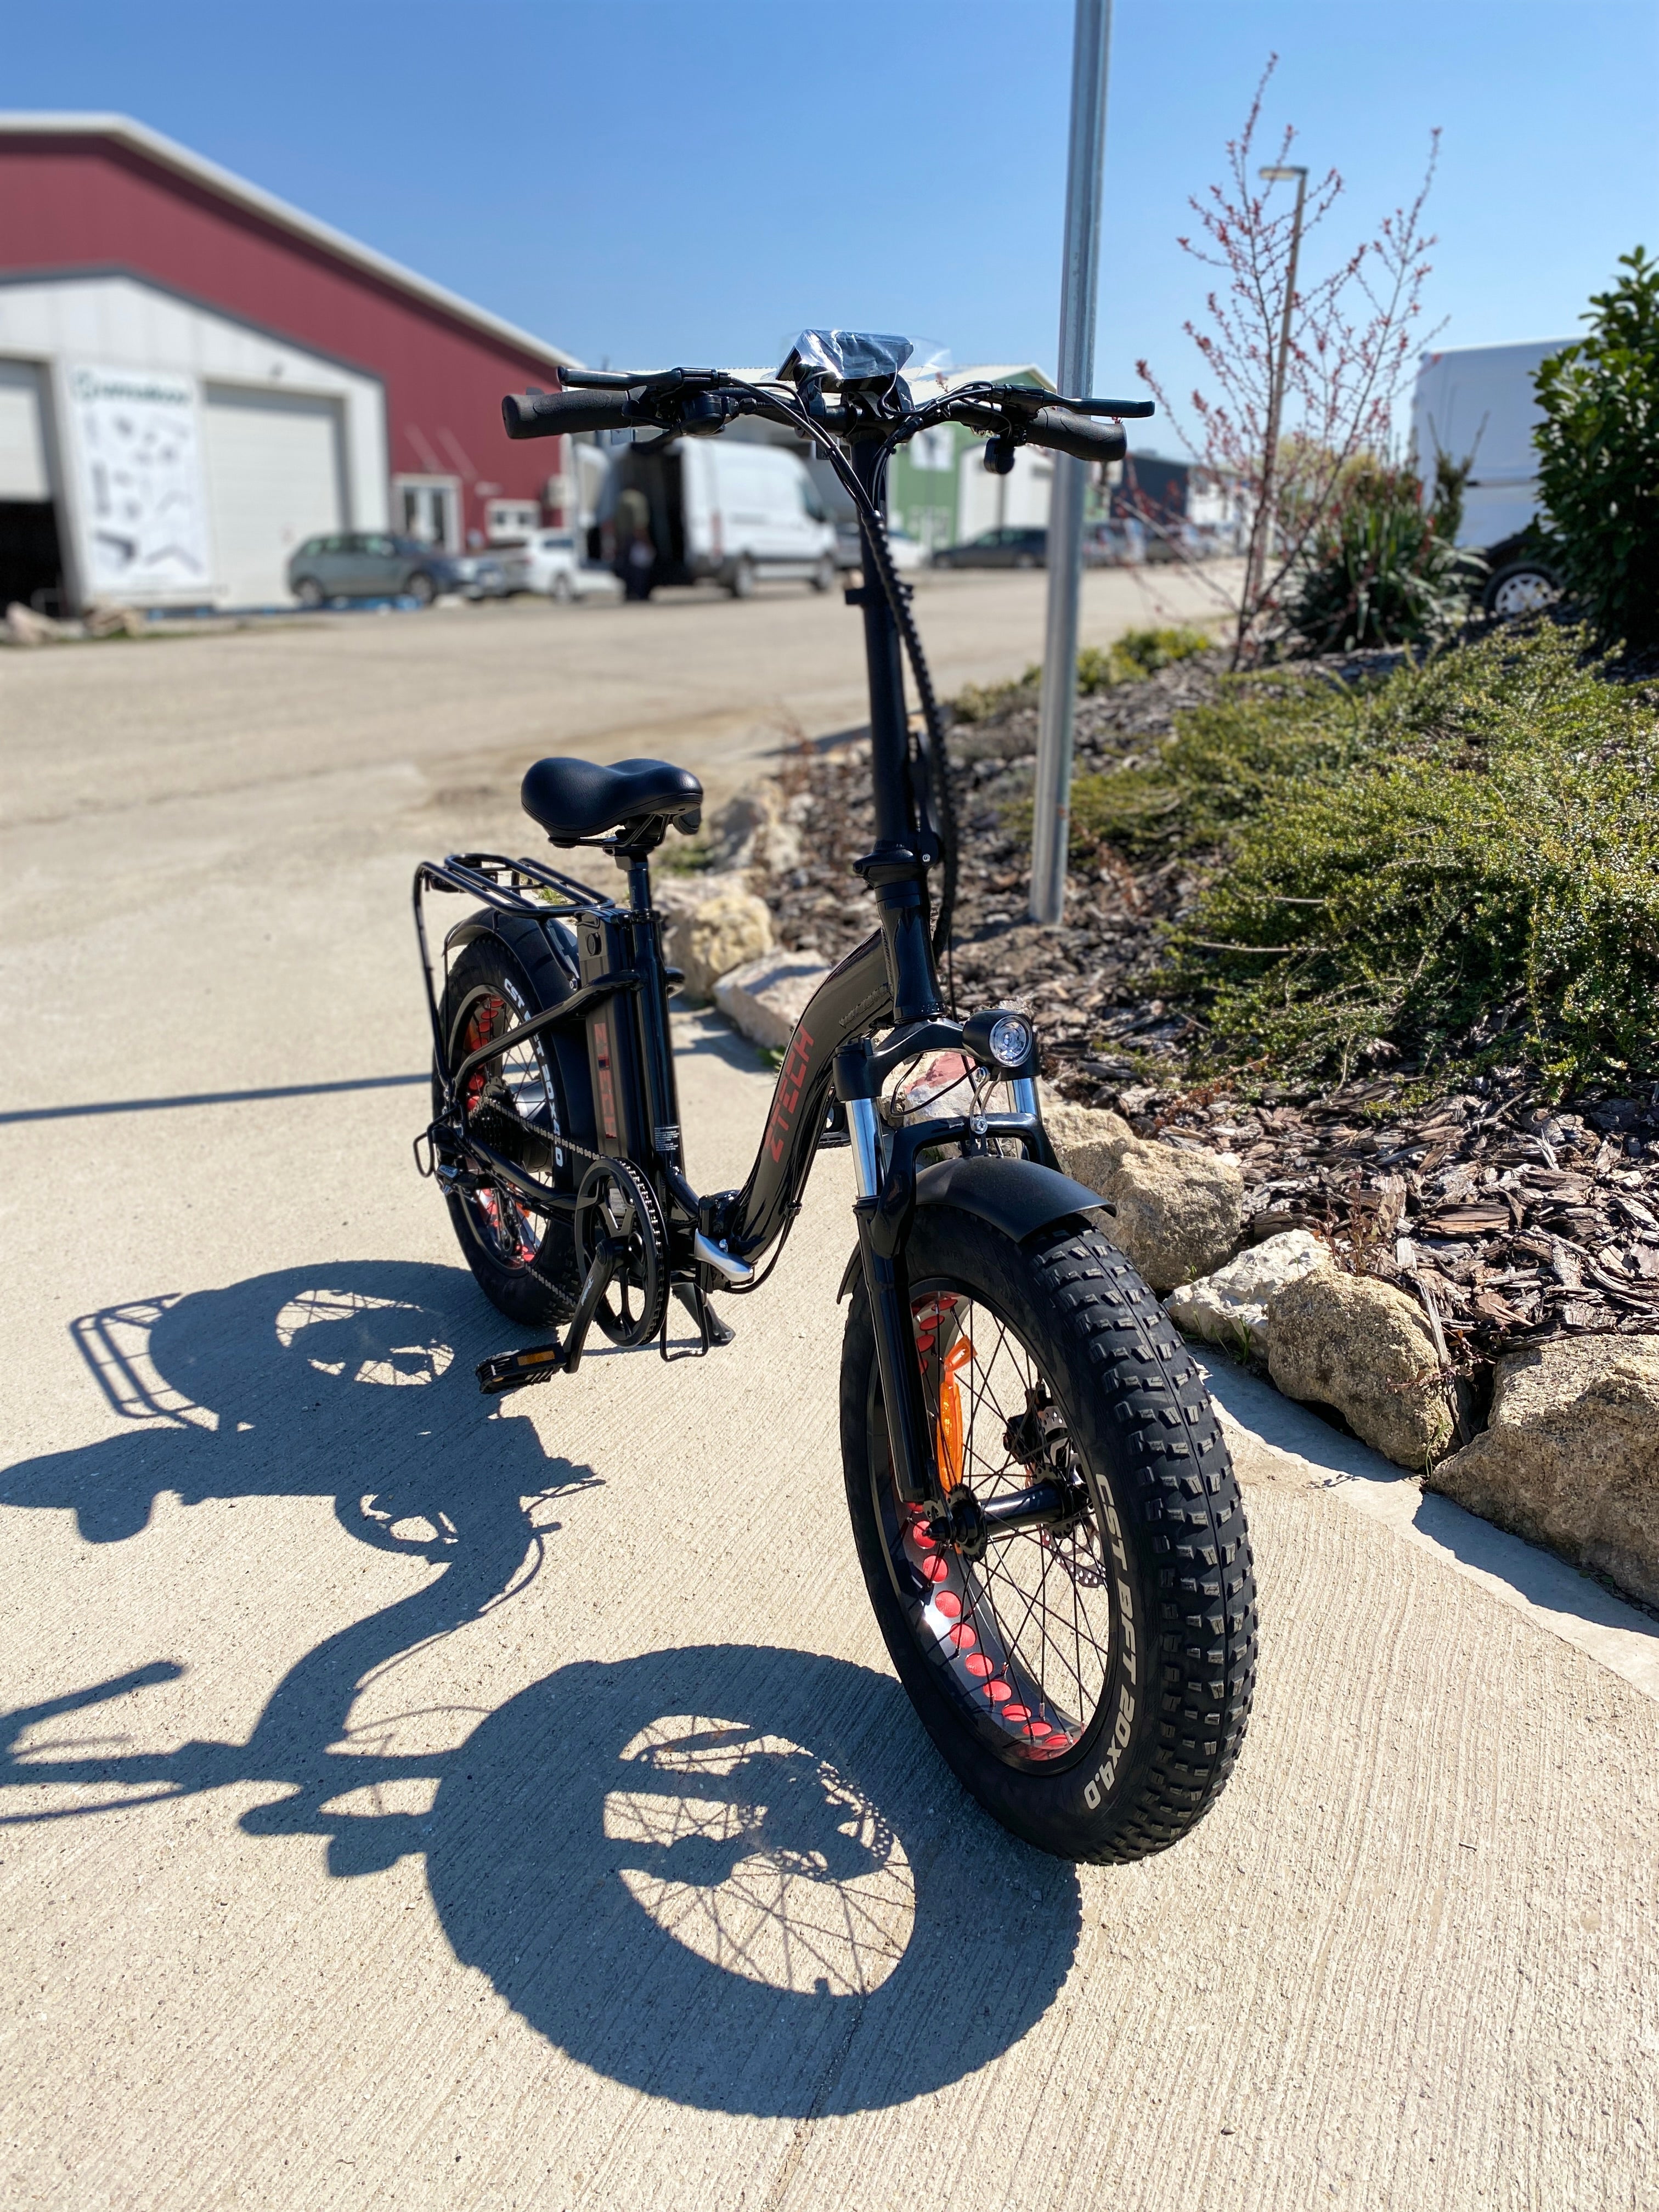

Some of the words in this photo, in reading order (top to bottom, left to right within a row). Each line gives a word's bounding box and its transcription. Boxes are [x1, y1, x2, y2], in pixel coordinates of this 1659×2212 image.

[504, 978, 525, 1009] CST
[765, 1024, 814, 1163] ZTECH
[1095, 1473, 1128, 1571] CST
[1117, 1577, 1136, 1685] BFT
